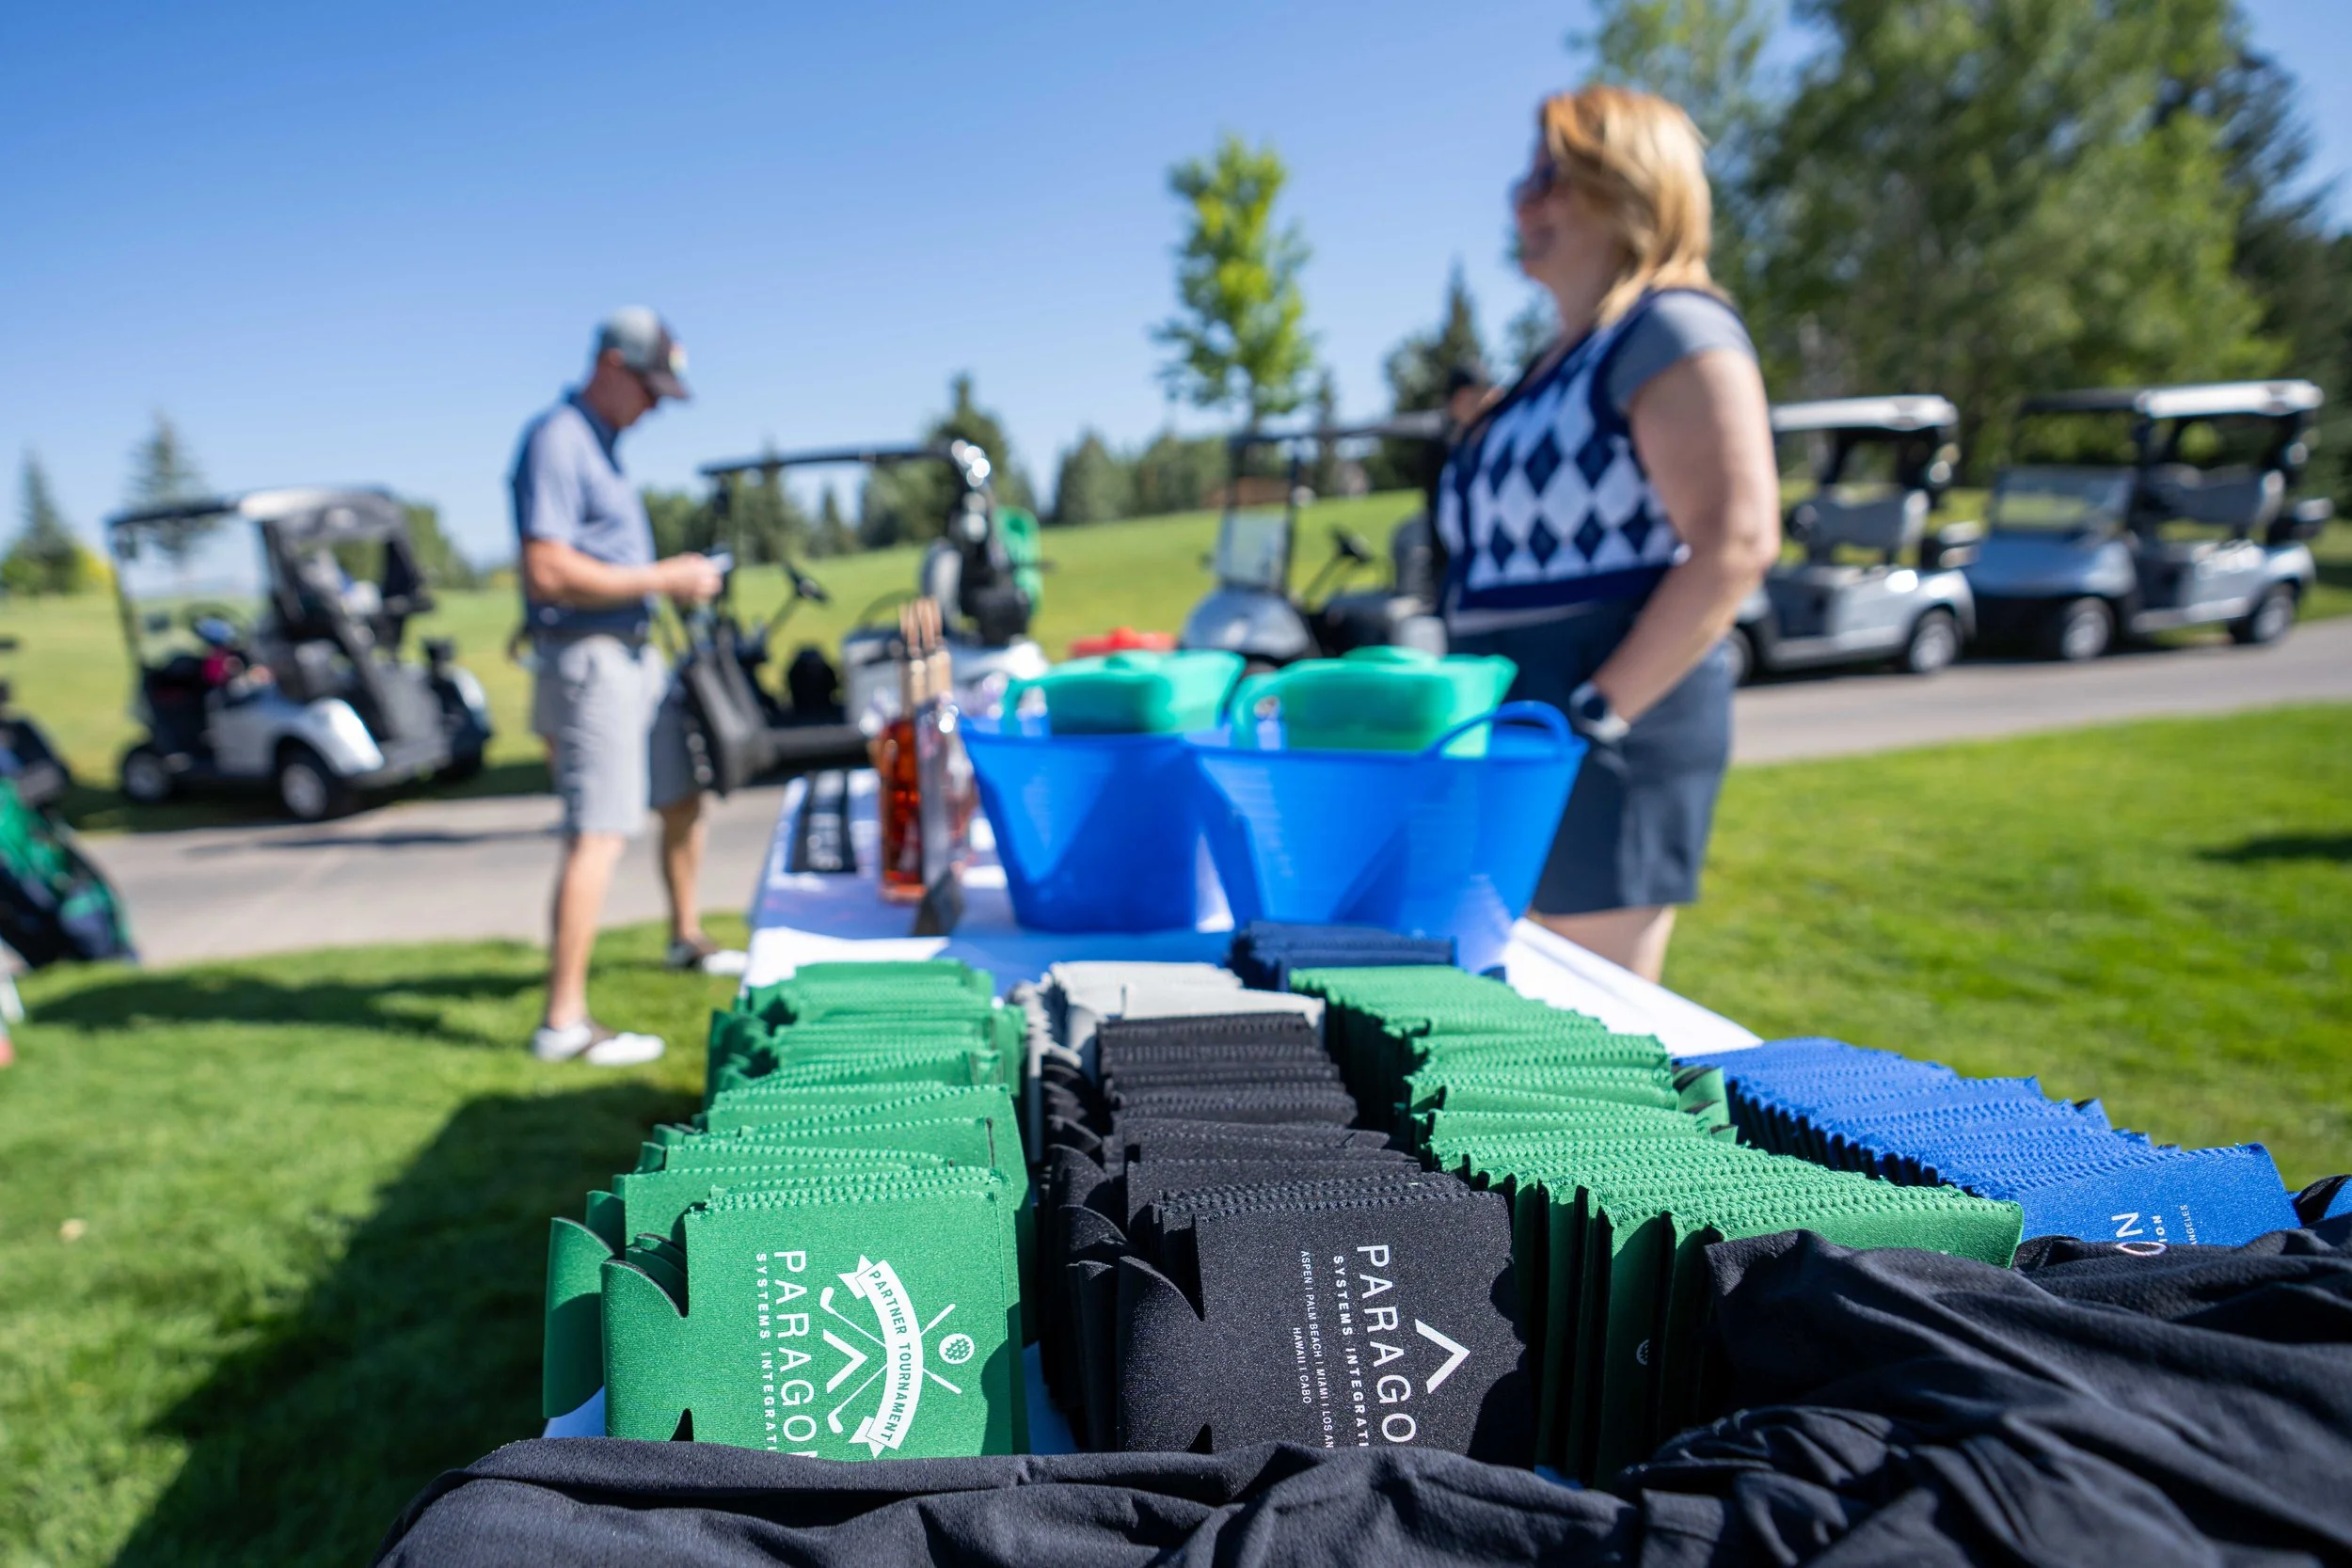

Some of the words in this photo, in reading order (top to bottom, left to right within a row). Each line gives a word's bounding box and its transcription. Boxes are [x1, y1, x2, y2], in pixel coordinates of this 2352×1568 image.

[1300, 1250, 1313, 1284] ASPEN
[755, 1253, 771, 1339] SYSTEMS
[868, 1270, 908, 1335] PARTNER
[1305, 1293, 1318, 1321] PALM
[1293, 1326, 1307, 1364] HAWAII
[1309, 1323, 1323, 1358] BEACH
[1332, 1255, 1354, 1337] SYSTEMS
[1344, 1347, 1370, 1448] INTEGRATI
[1356, 1243, 1418, 1443] PARAGO
[760, 1352, 778, 1451] INTEGRATI
[880, 1341, 913, 1442] TOURNAMENT
[1298, 1374, 1312, 1404] CABO
[1316, 1368, 1330, 1400] MIAMI
[1322, 1410, 1334, 1432] LOS
